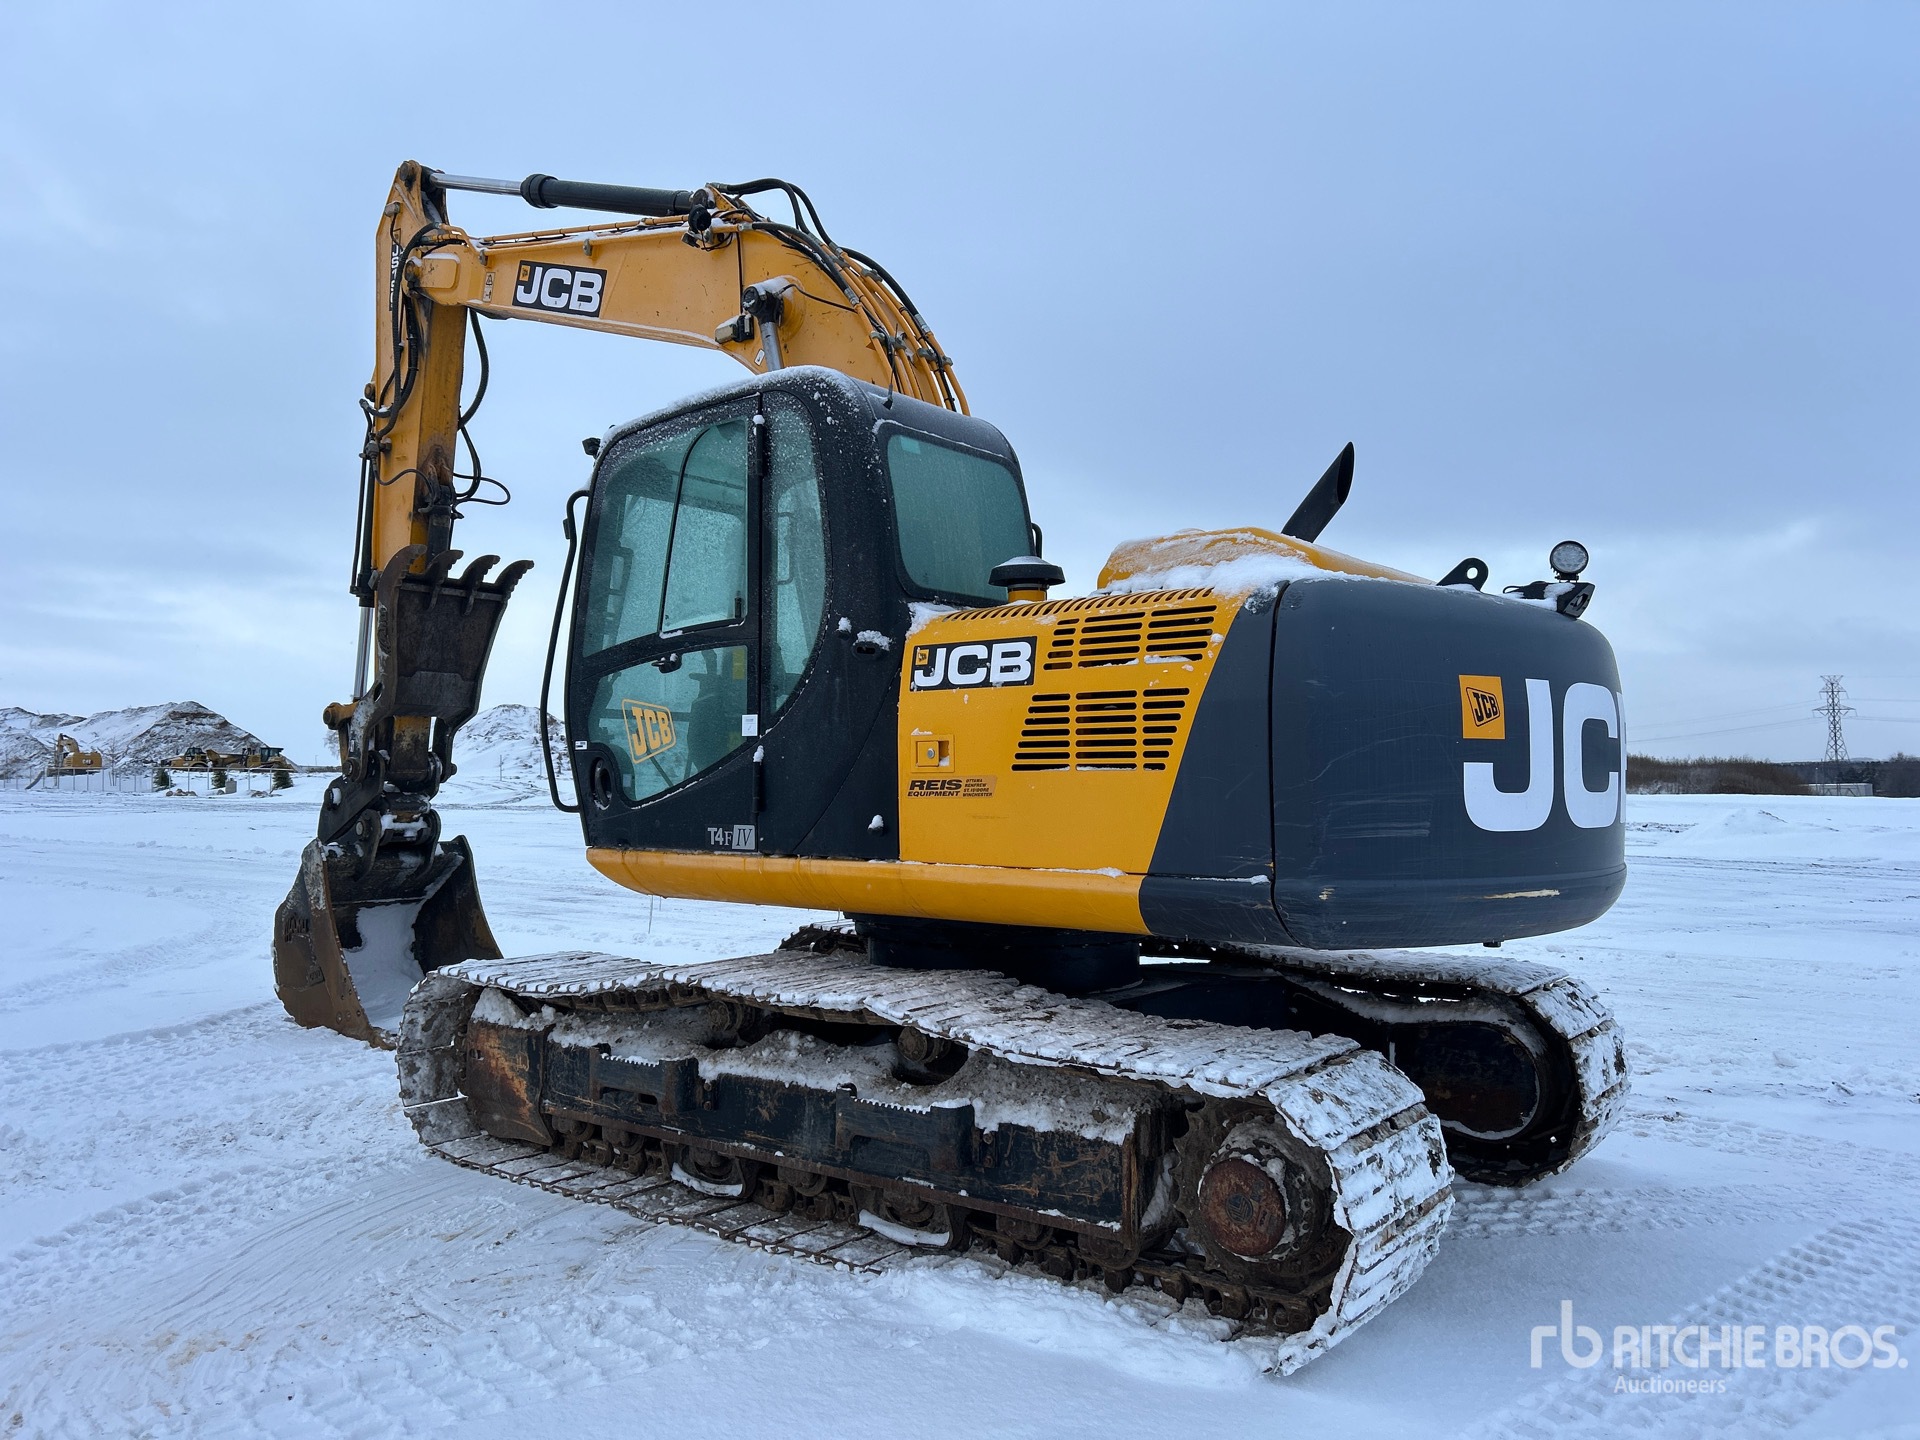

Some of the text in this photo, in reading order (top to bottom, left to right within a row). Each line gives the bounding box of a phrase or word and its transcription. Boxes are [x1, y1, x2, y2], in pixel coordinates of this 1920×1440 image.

[516, 266, 602, 313] JCB
[913, 641, 1032, 687] JCB
[1473, 691, 1499, 722] JCB
[631, 706, 672, 756] JCB
[1463, 678, 1628, 832] JC
[909, 779, 962, 790] REIS
